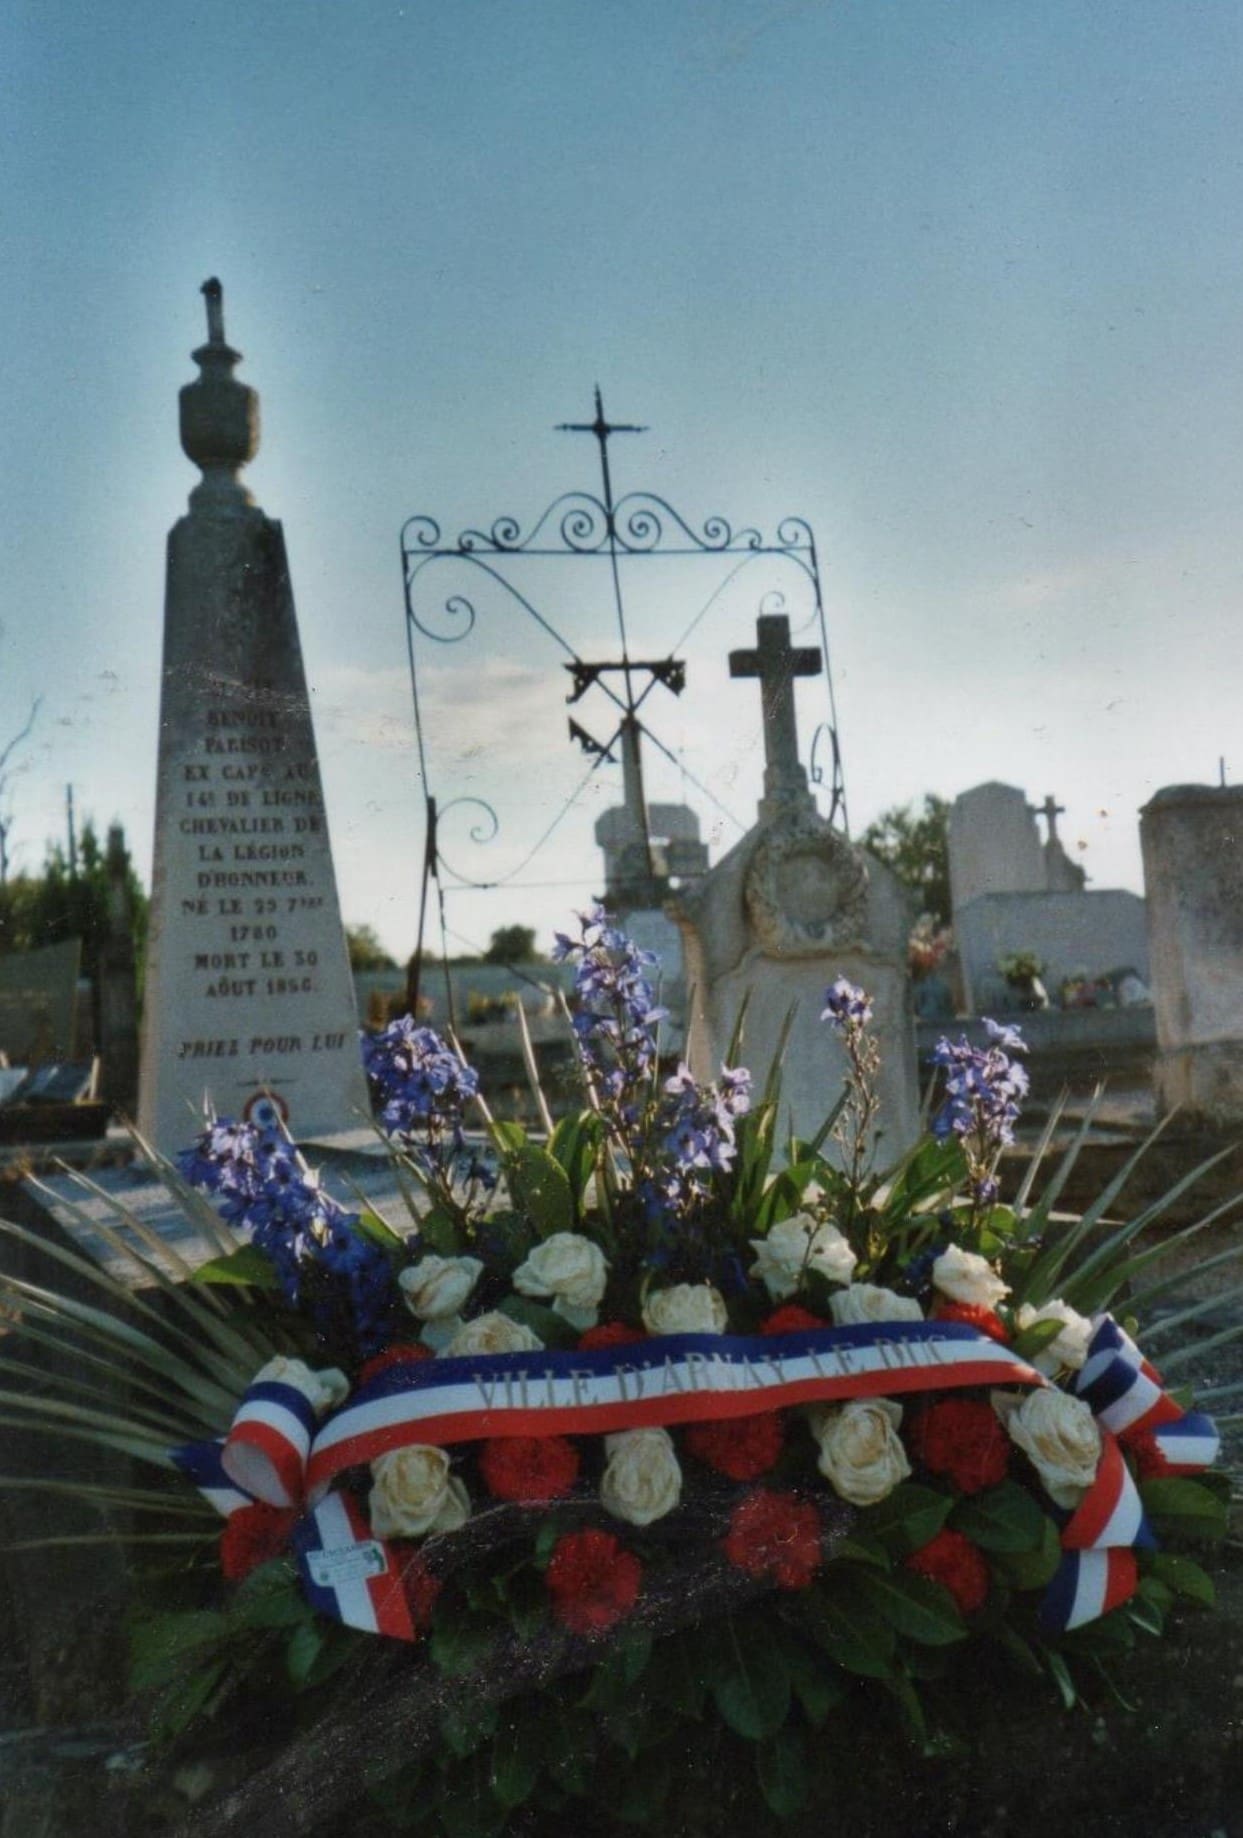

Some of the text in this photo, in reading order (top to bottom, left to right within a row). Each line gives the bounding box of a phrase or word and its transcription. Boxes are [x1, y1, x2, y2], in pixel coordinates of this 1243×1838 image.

[205, 736, 285, 753] PARISOT
[184, 765, 209, 781] EX
[226, 790, 250, 806] DE
[263, 789, 319, 806] LIGNE
[179, 815, 321, 835] CHEVALIER DE
[198, 844, 223, 861] LA
[181, 893, 208, 915] NÉ
[218, 898, 242, 915] LE
[195, 949, 318, 970] MORT LE 30
[178, 1033, 346, 1060] PRIEZ POUR LUI
[473, 1334, 957, 1410] VILLE D'ARNAY LE DUC
